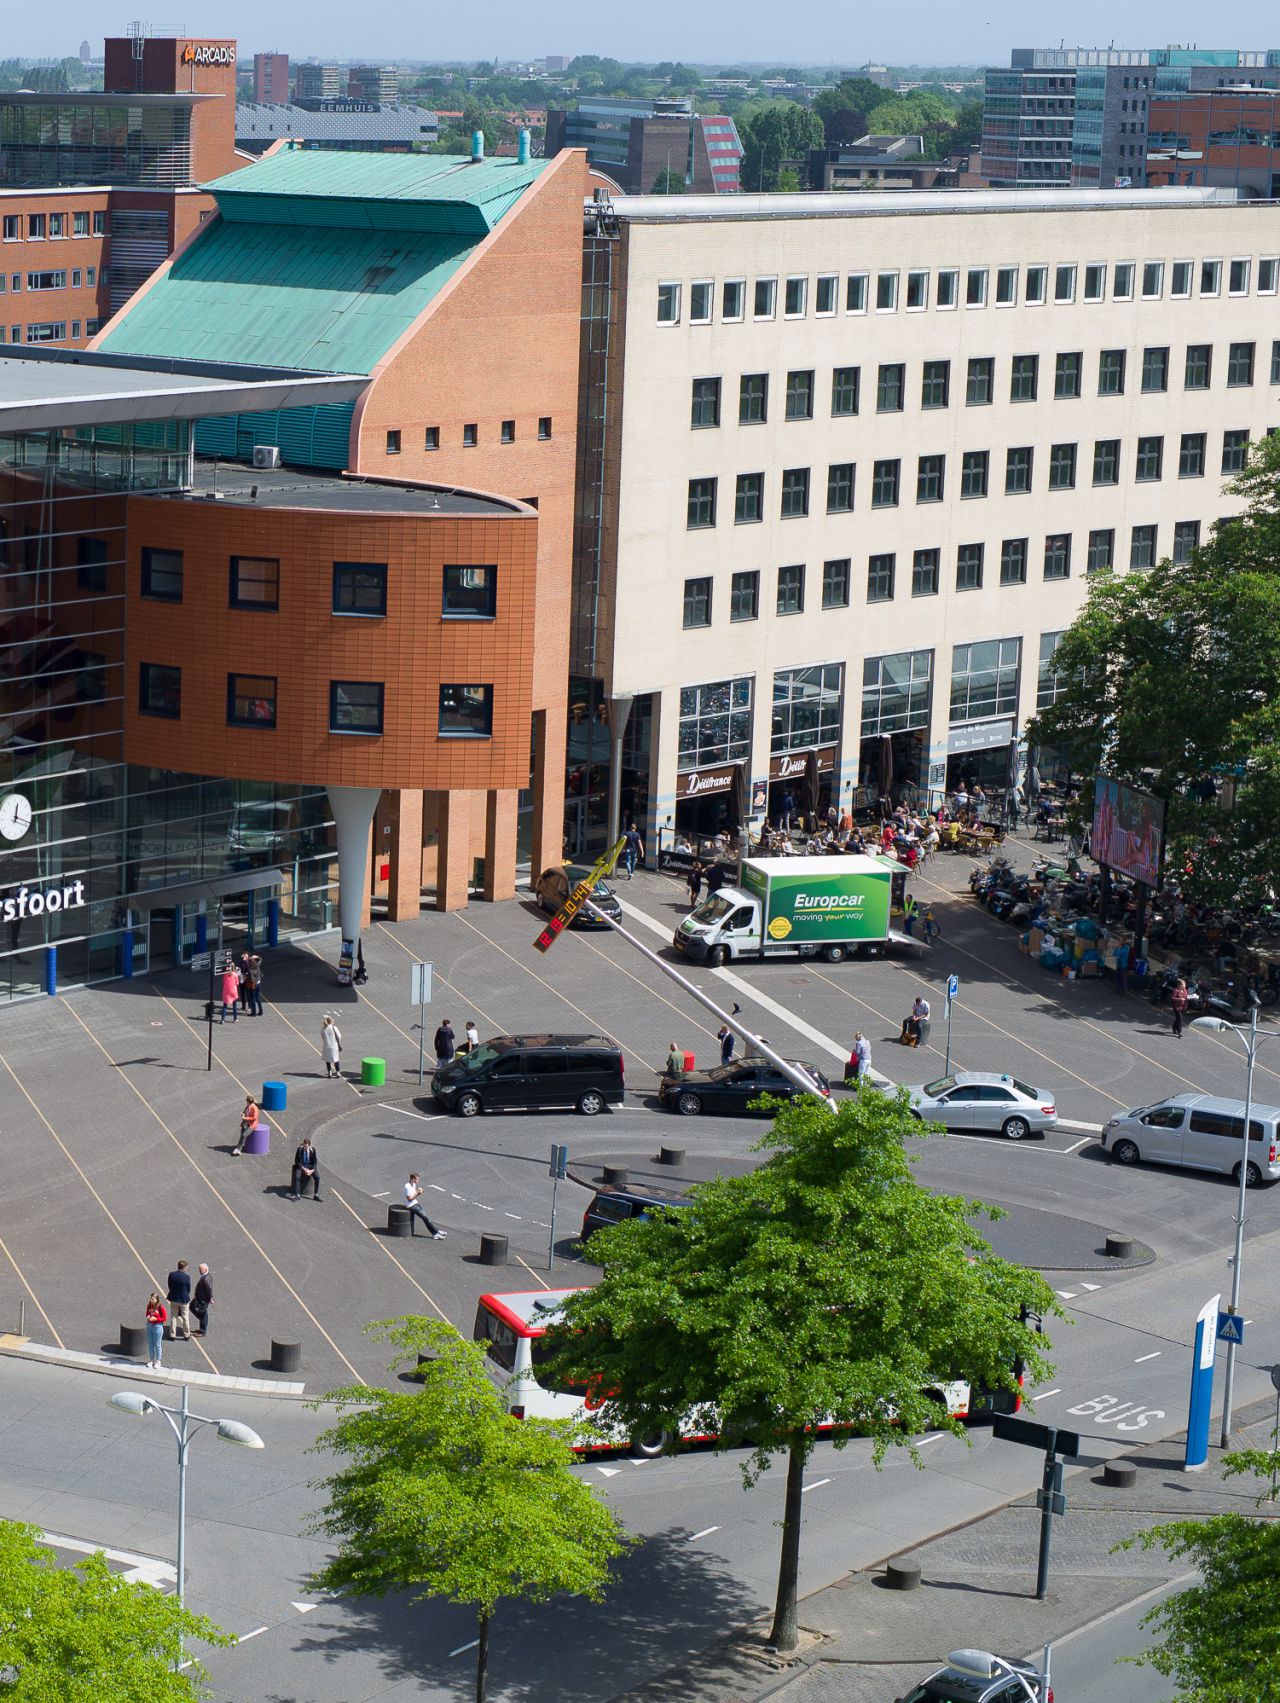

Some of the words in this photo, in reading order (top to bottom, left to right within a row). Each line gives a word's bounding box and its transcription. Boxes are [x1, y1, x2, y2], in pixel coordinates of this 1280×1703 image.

[195, 47, 236, 63] ARCADIS
[320, 104, 374, 112] EEMHUIS
[778, 755, 823, 776] Délifre
[686, 773, 732, 794] Délifrance
[98, 841, 172, 853] OUDHOORN
[794, 893, 865, 911] Europcar
[793, 913, 823, 922] moving
[824, 913, 845, 922] your
[845, 912, 864, 921] way
[1066, 1394, 1165, 1431] BUS
